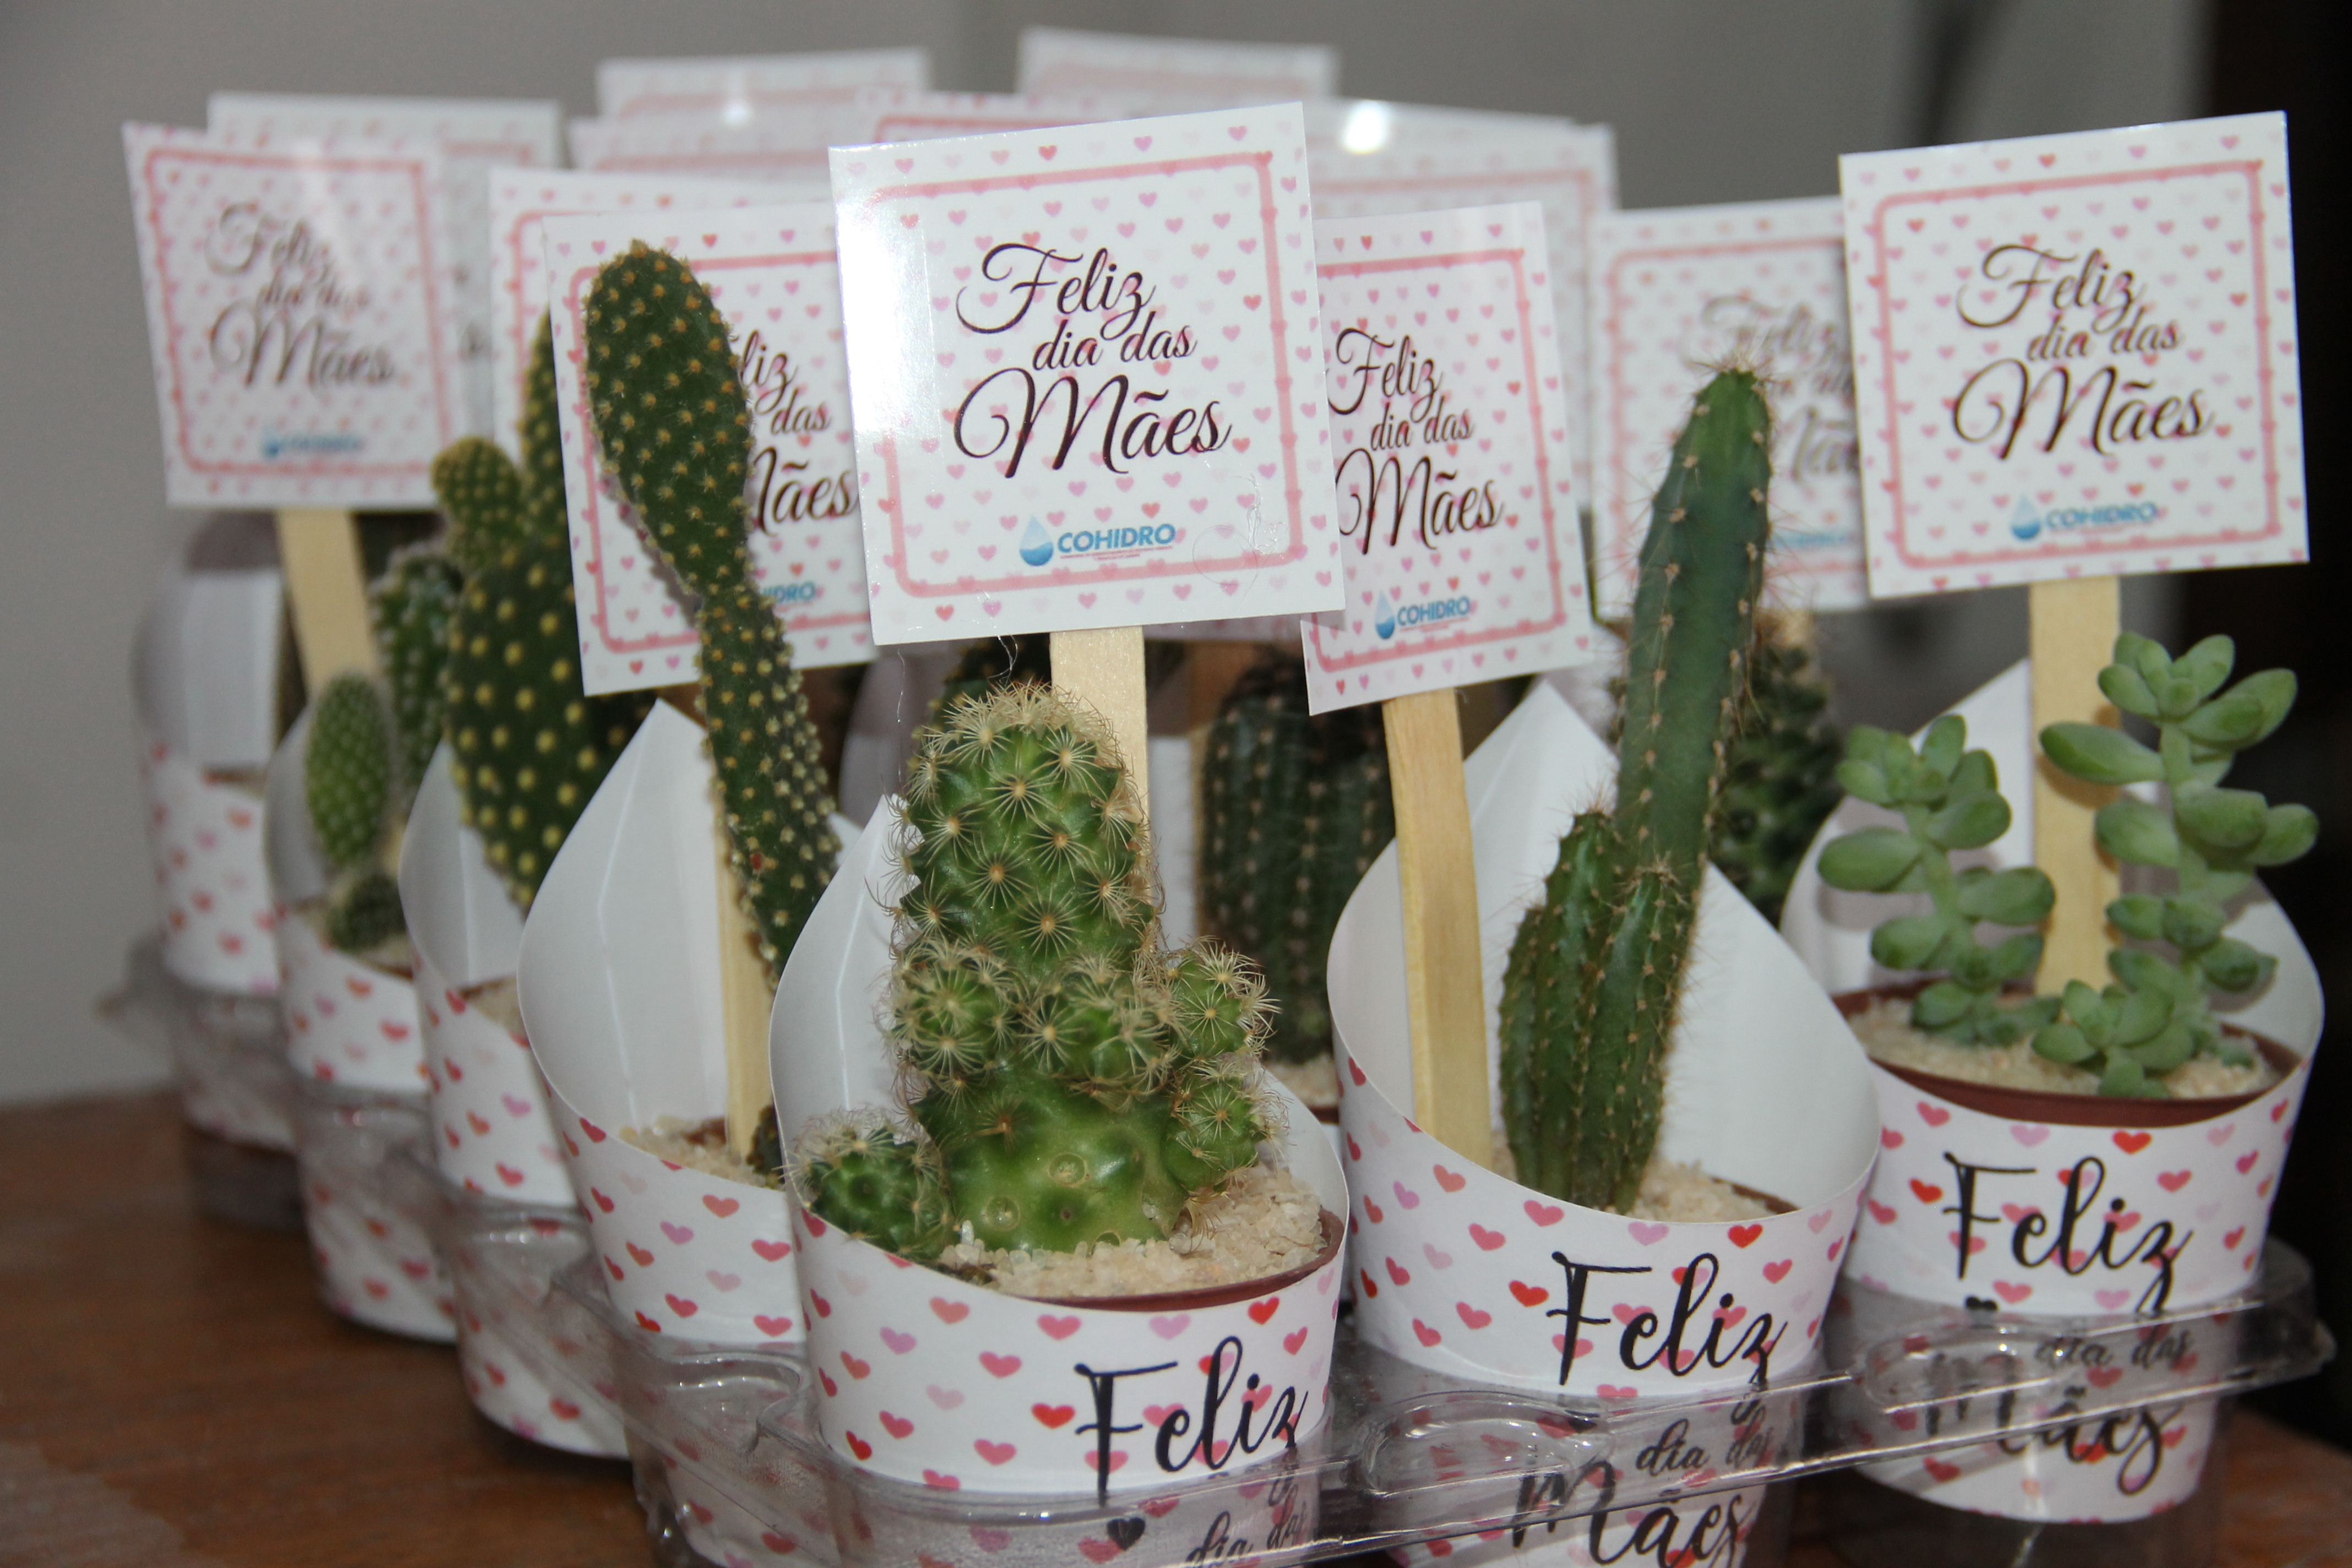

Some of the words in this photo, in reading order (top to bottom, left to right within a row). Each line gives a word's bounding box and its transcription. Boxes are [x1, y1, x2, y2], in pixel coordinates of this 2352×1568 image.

[956, 243, 1157, 340] Feliz
[1956, 244, 2148, 334] Feliz
[739, 330, 798, 415] liz
[1032, 319, 1103, 371] dia
[1120, 311, 1197, 363] das
[1326, 328, 1443, 423] Feliz
[2027, 314, 2091, 362] dia
[2110, 307, 2185, 355] das
[771, 386, 831, 435] das
[954, 367, 1233, 478] Mães
[1370, 402, 1413, 450] dia
[1417, 395, 1474, 444] das
[1952, 358, 2214, 460] Mães
[1057, 524, 1176, 553] COHIDRO
[1336, 448, 1504, 555] Mães
[2046, 502, 2157, 529] COHIDRO
[1397, 596, 1469, 626] COHIDRO
[1942, 1152, 2194, 1319] Feliz
[1546, 1251, 1788, 1425] Feliz
[1074, 1336, 1309, 1507] Feliz
[1634, 1418, 1710, 1477] dia
